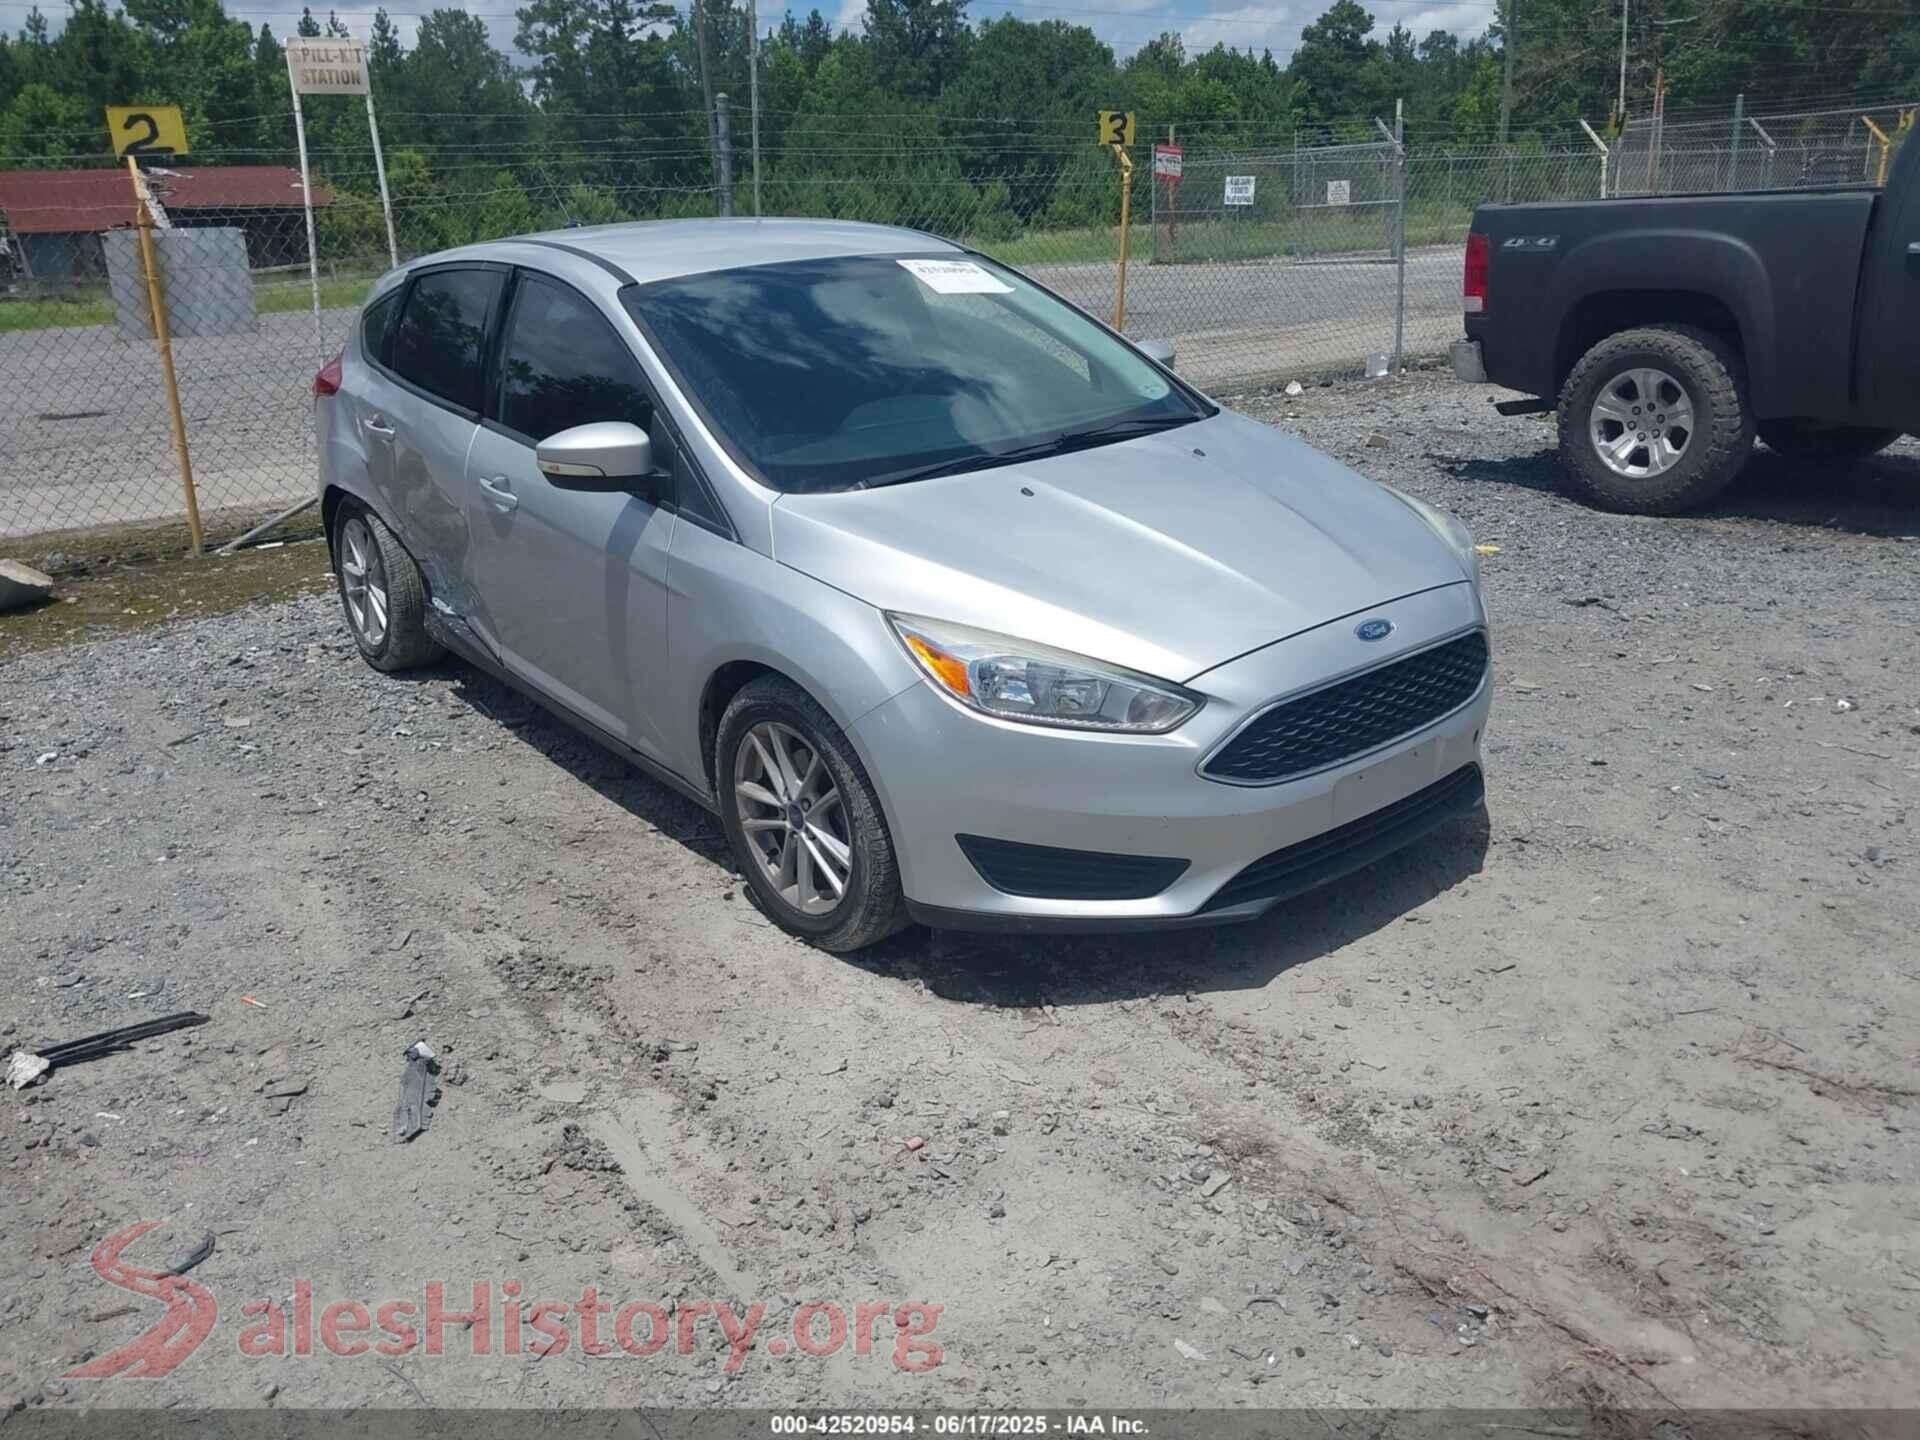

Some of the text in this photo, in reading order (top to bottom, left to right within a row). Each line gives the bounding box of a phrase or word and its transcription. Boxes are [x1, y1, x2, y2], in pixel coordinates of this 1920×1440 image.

[302, 68, 362, 85] STATION
[121, 112, 175, 154] 2
[1108, 111, 1128, 145] 3
